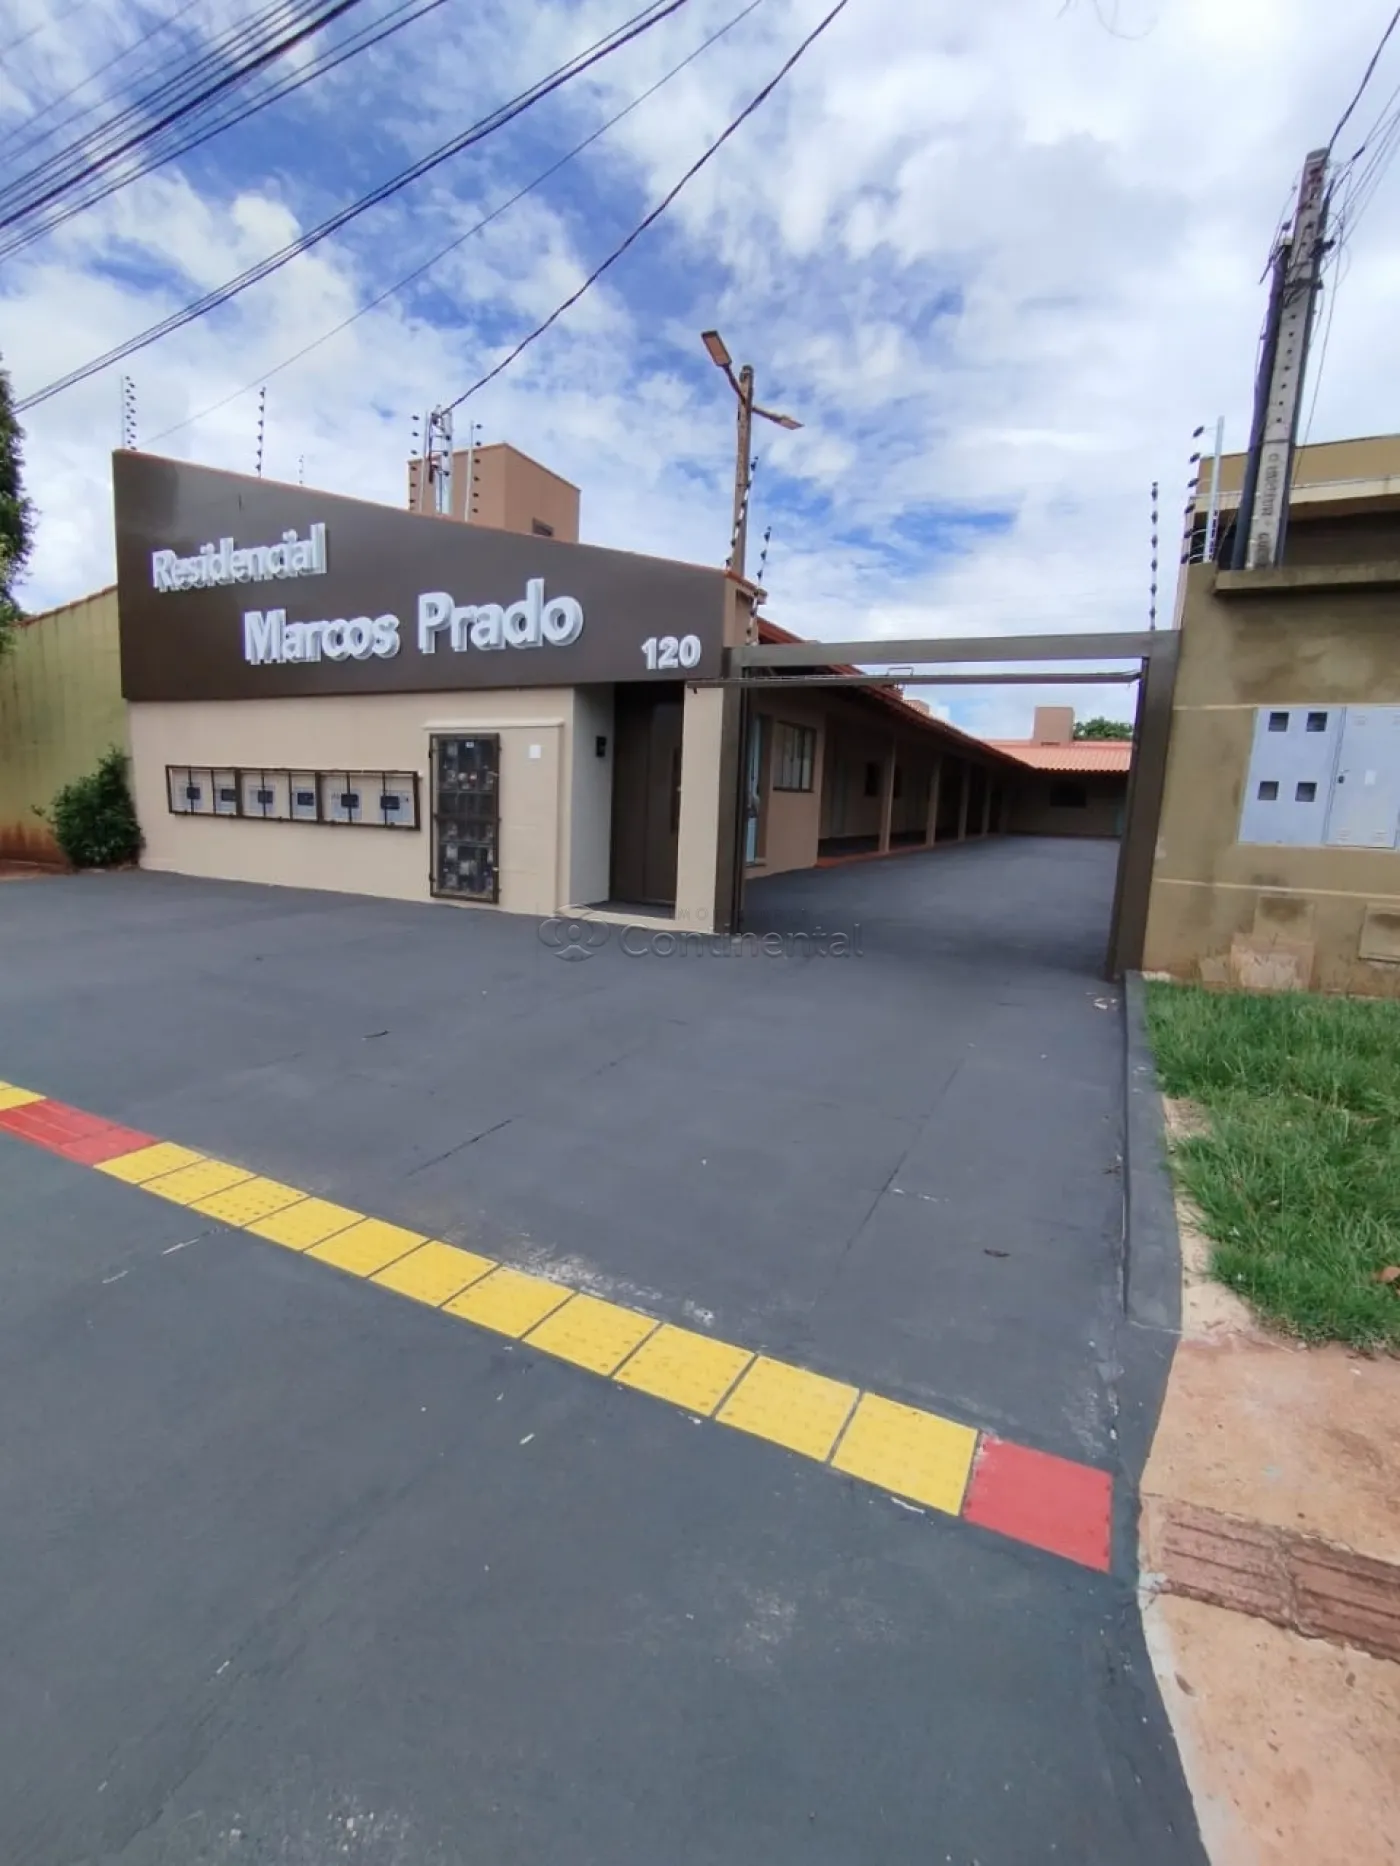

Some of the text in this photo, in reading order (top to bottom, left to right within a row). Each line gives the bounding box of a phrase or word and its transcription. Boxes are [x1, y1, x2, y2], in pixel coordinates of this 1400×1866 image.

[152, 523, 327, 592] Residencial
[244, 578, 583, 665] Marcos Prado
[641, 634, 702, 670] 120
